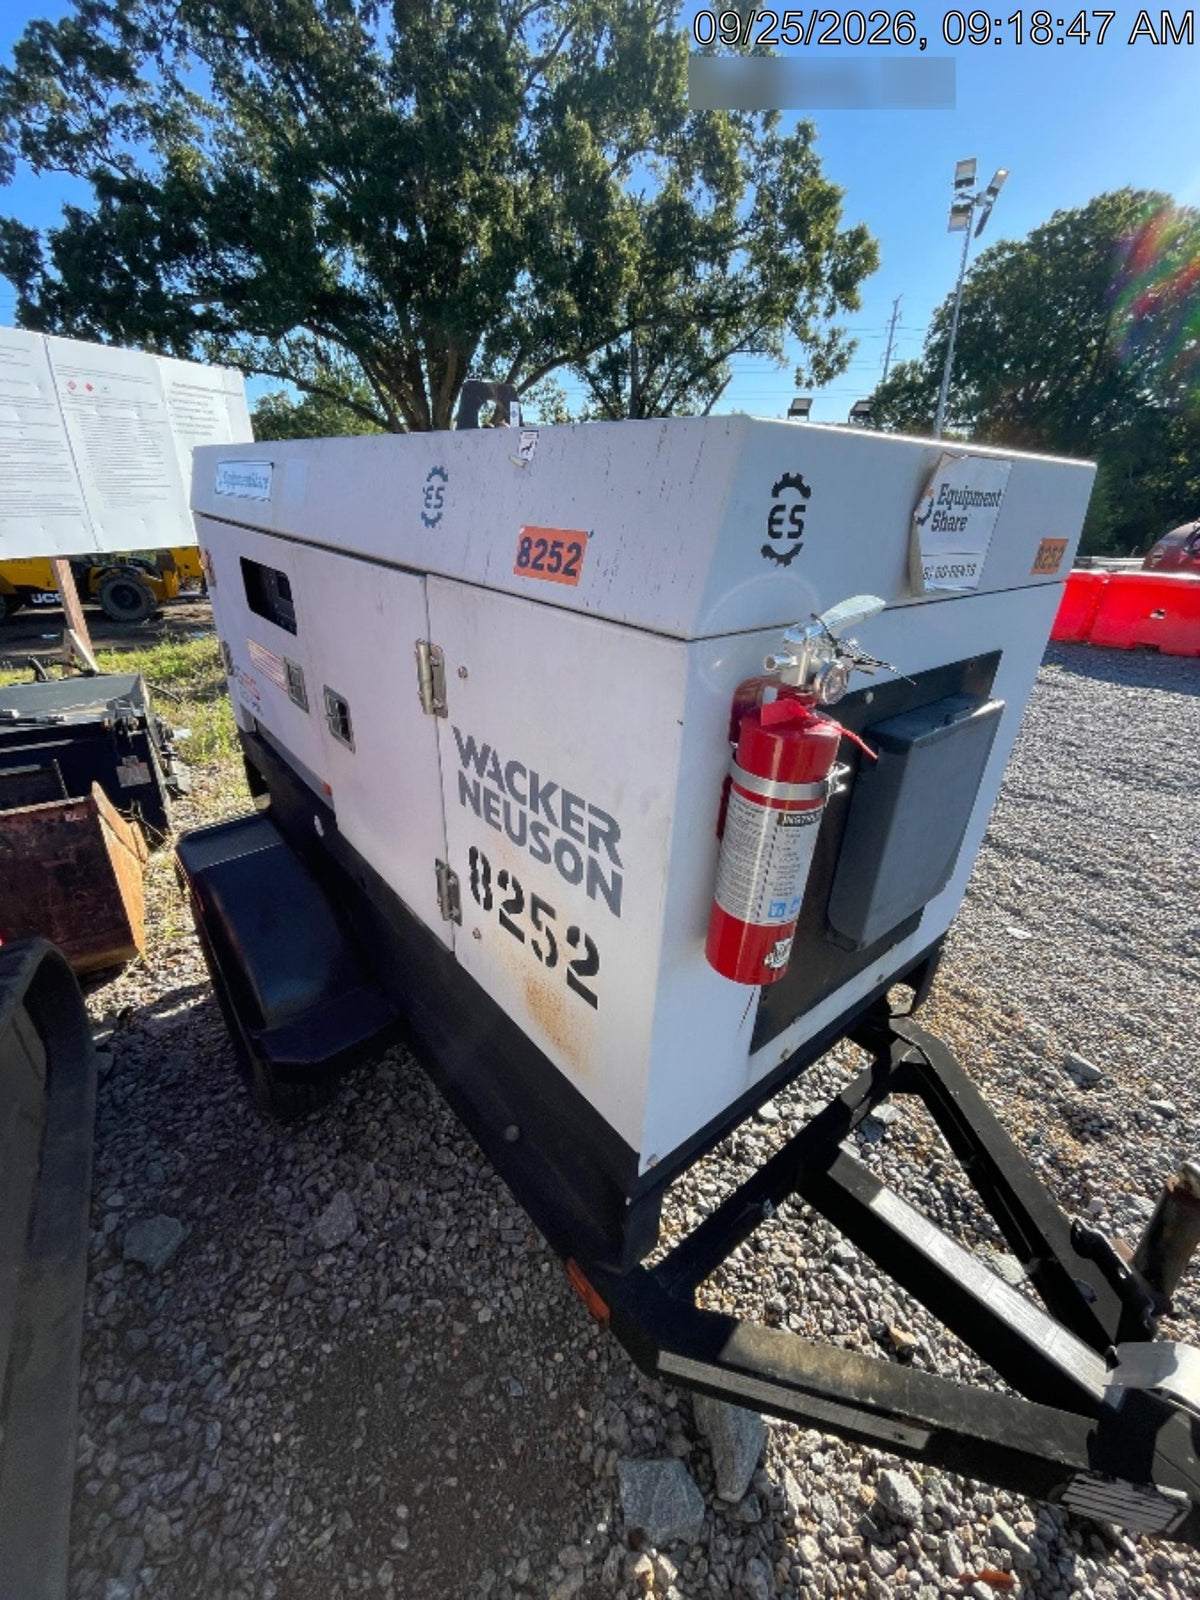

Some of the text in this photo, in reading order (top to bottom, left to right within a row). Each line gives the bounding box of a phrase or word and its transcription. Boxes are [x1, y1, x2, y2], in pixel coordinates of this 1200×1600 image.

[936, 483, 1003, 511] Equipment
[767, 504, 807, 539] ES
[931, 510, 968, 532] Share
[516, 536, 582, 577] 8252
[451, 724, 624, 870] WACKER
[458, 769, 624, 919] NEUSON
[468, 845, 600, 1011] 8252
